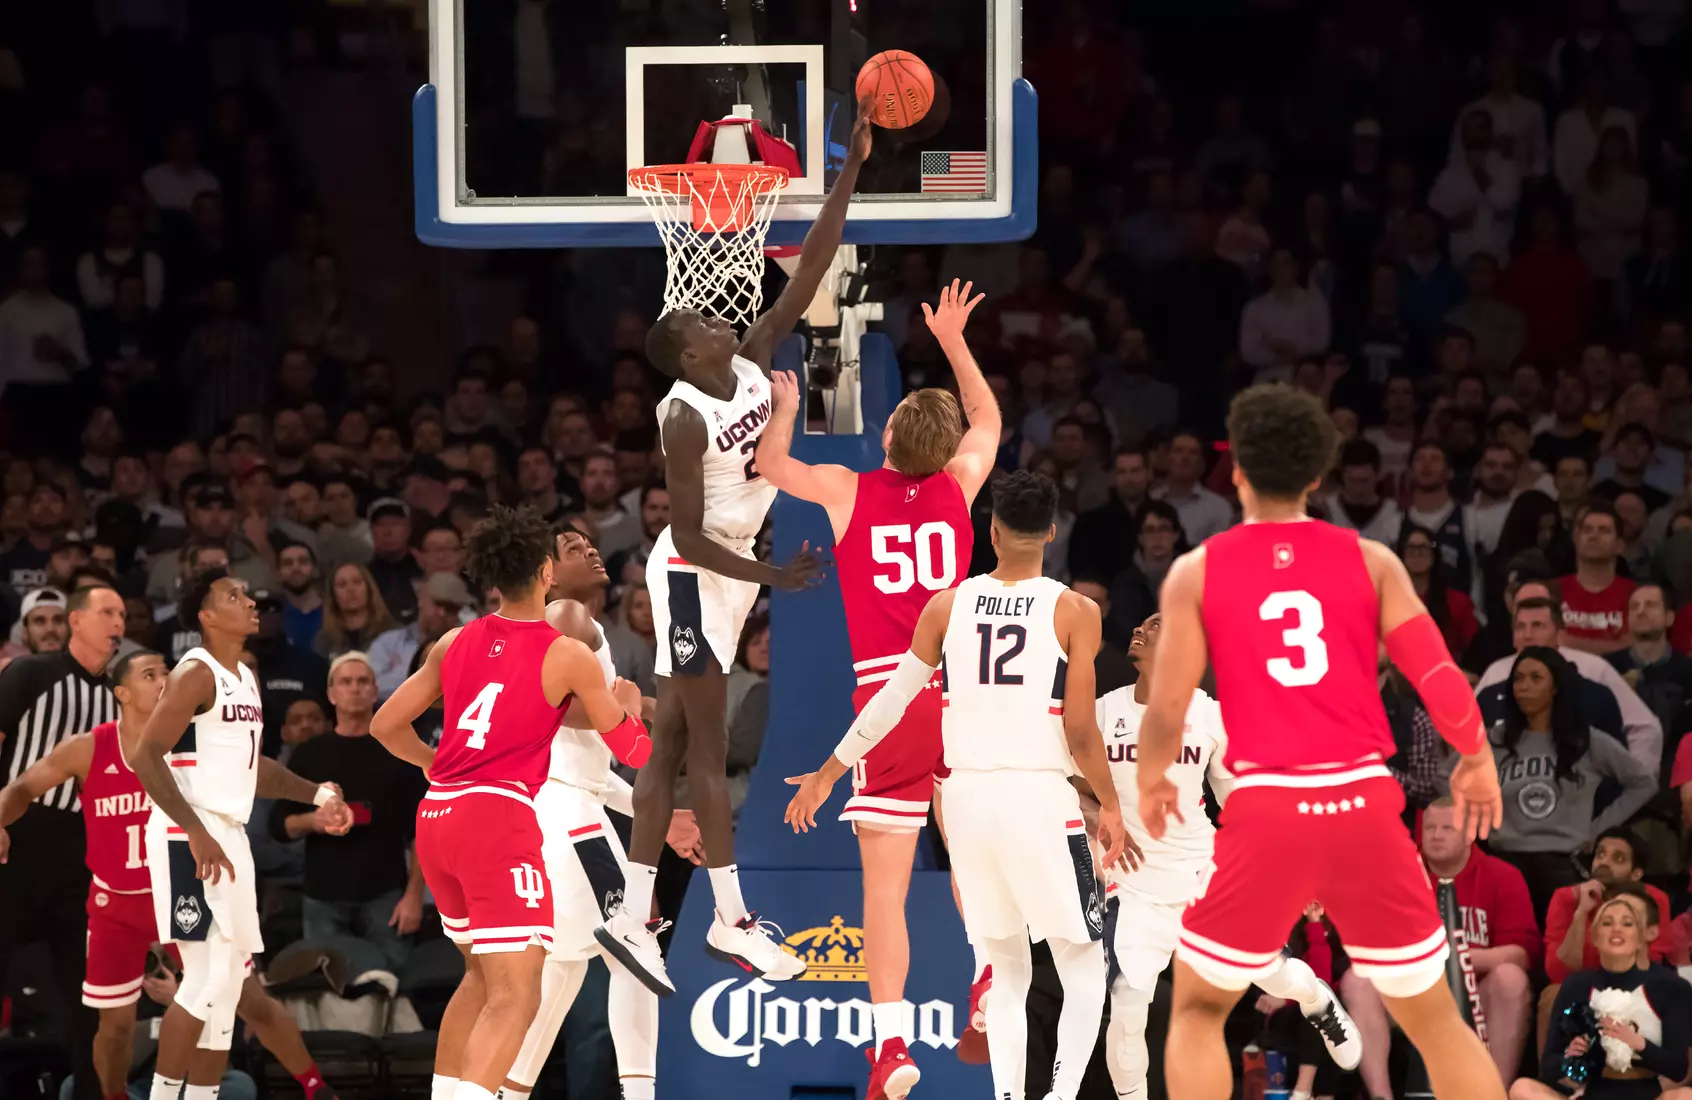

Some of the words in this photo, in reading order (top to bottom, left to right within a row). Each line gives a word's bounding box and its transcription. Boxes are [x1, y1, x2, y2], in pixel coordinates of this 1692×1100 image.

[716, 399, 771, 452] UCONN
[871, 521, 956, 594] 50
[975, 596, 1035, 616] POLLEY
[976, 623, 1027, 685] 12
[1259, 590, 1329, 687] 3
[222, 704, 264, 723] UCON
[457, 682, 504, 750] 4
[249, 730, 255, 769] 1
[1107, 744, 1201, 764] UCN
[94, 791, 153, 817] INDIA
[125, 824, 150, 869] 1
[1452, 928, 1489, 1050] HUSKIE
